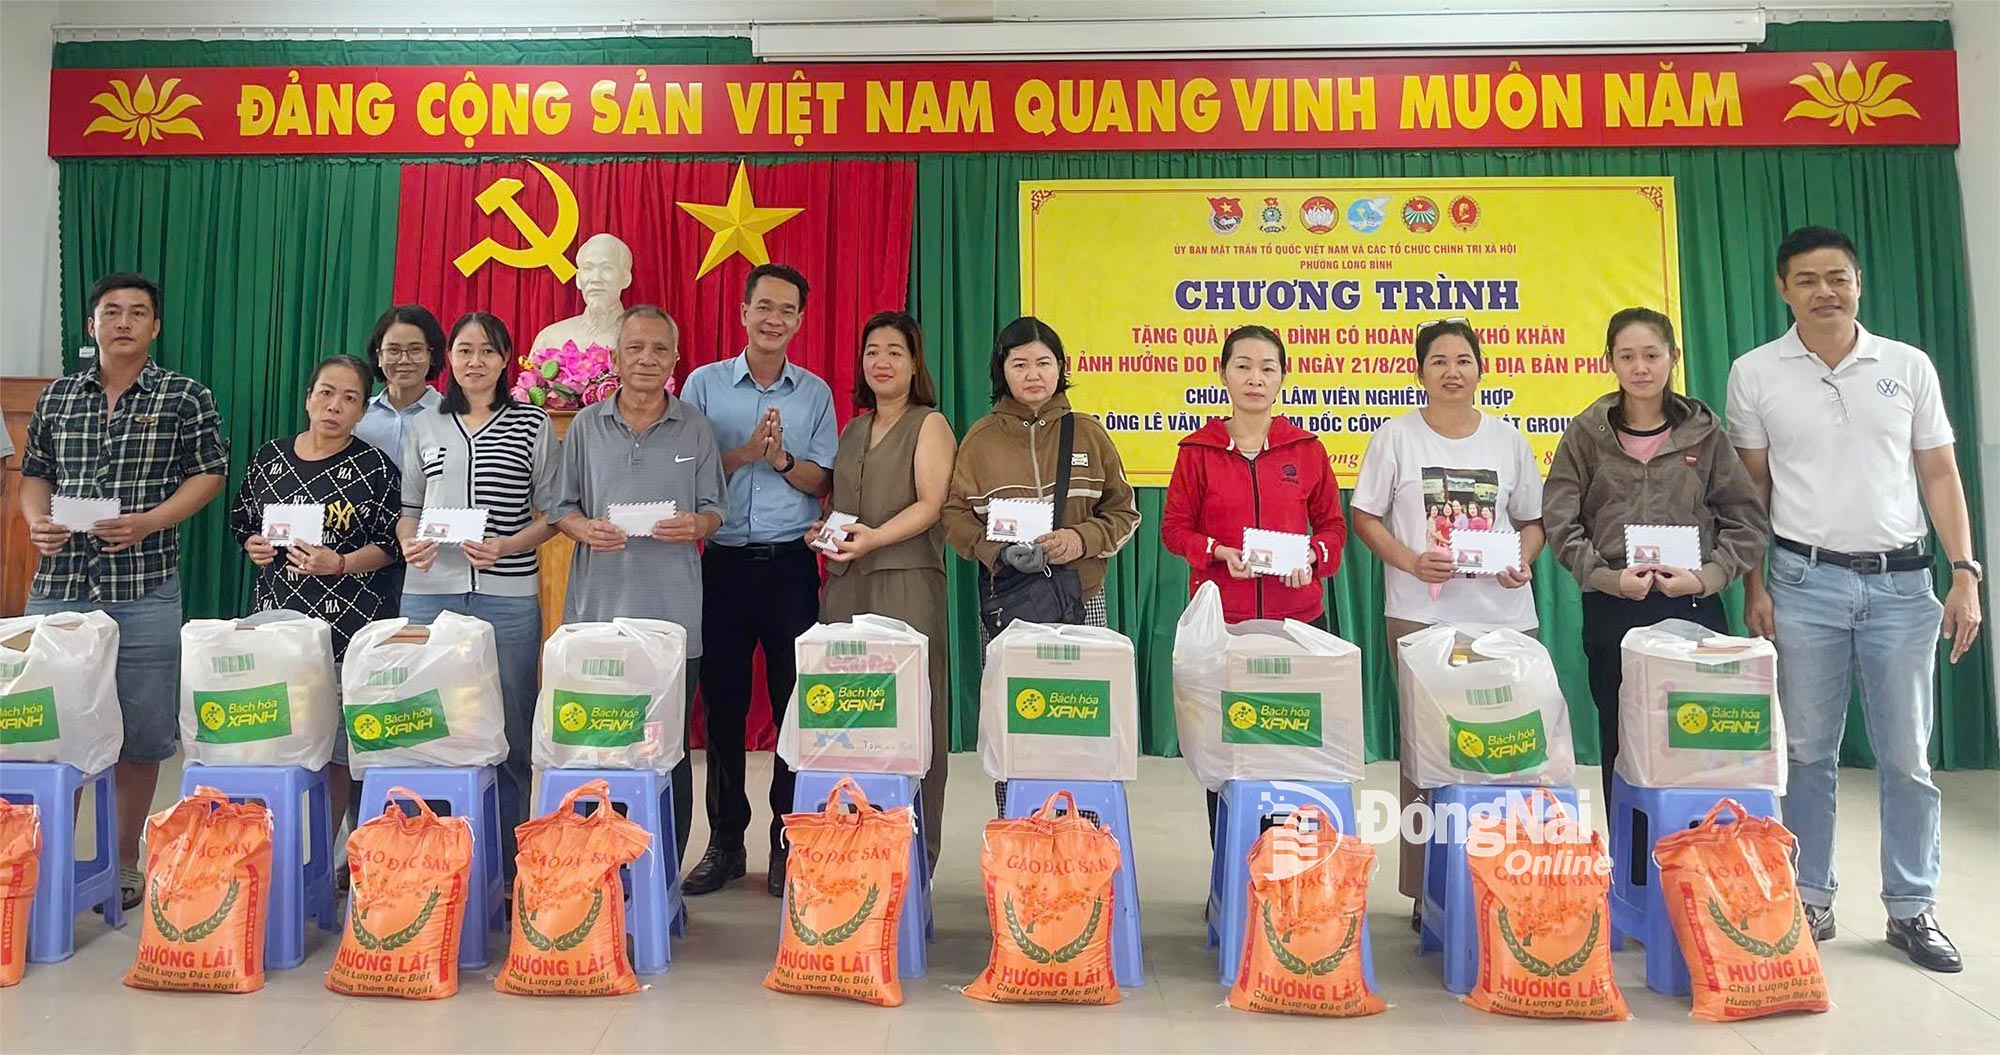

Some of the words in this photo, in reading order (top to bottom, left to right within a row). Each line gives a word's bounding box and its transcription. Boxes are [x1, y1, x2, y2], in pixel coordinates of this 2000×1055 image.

[236, 70, 394, 137] ĐẢNG
[417, 70, 572, 148] CỘNG
[591, 68, 702, 136] SẢN
[725, 69, 845, 147] VIỆT
[866, 79, 994, 134] NAM
[1015, 78, 1221, 138] QUANG
[1230, 76, 1376, 133] VINH
[1400, 60, 1583, 132] MUÔN
[1604, 61, 1744, 129] NĂM
[1174, 242, 1187, 254] ỦY
[1189, 244, 1208, 254] BAN
[1211, 242, 1230, 254] MẶT
[1233, 242, 1257, 254] TRẬN
[1260, 242, 1272, 254] TỔ
[1275, 242, 1301, 254] QUỐC
[1304, 242, 1325, 254] VIỆT
[1328, 245, 1349, 254] NAM
[1352, 242, 1365, 254] VÀ
[1367, 242, 1386, 254] CÁC
[1390, 242, 1401, 254] TỔ
[1404, 242, 1431, 254] CHỨC
[1434, 242, 1462, 254] CHÍNH
[1466, 244, 1482, 256] TRỊ
[1485, 242, 1497, 254] XÃ
[1499, 242, 1516, 256] HỘI
[1300, 259, 1339, 270] PHƯỜNG
[1342, 261, 1366, 270] LONG
[1369, 259, 1392, 270] BÌNH
[1175, 279, 1361, 311] CHƯƠNG
[1376, 273, 1520, 311] TRÌNH
[1132, 325, 1177, 347] TẶNG
[1183, 325, 1218, 345] QUÀ
[1288, 324, 1330, 345] ĐÌNH
[1337, 325, 1360, 345] CÓ
[1365, 325, 1414, 345] HOÀN
[1474, 326, 1511, 345] KHÓ
[1516, 325, 1565, 345] KHĂN
[1077, 351, 1113, 373] ẢNH
[1119, 350, 1178, 373] HƯỞNG
[1184, 356, 1207, 373] DO
[1298, 353, 1345, 373] NGÀY
[1351, 357, 1417, 374] 21/8/20
[1495, 357, 1526, 377] ĐỊA
[1532, 354, 1569, 374] BÀN
[1185, 386, 1230, 405] CHÙA
[1282, 386, 1317, 406] LÂM
[1322, 386, 1359, 406] VIÊN
[1365, 386, 1430, 406] NGHIÊM
[1481, 388, 1514, 409] HỢP
[1105, 411, 1139, 431] ÔNG
[1144, 411, 1163, 431] LÊ
[1167, 411, 1201, 431] VĂN
[1309, 410, 1341, 432] ĐỐC
[1526, 417, 1574, 433] GROU
[1329, 453, 1359, 469] ong
[836, 698, 886, 712] XANH
[1046, 704, 1099, 719] XANH
[227, 709, 278, 728] XANH
[384, 717, 433, 738] XANH
[587, 717, 634, 731] XANH
[1259, 716, 1310, 731] XANH
[1709, 720, 1760, 734] XANH
[1486, 742, 1536, 759] XANH
[140, 945, 195, 968] HƯƠNG
[202, 945, 233, 968] LÀI
[338, 946, 392, 972] HƯƠNG
[399, 951, 429, 973] LÀI
[511, 952, 569, 976] HƯƠNG
[576, 952, 605, 977] LÀI
[780, 949, 834, 972] HƯƠNG
[841, 950, 870, 973] LÀI
[1001, 966, 1067, 987] HƯƠNG
[1727, 959, 1795, 984] HƯƠNG
[1799, 953, 1820, 976] LÀI
[1257, 972, 1325, 1000] HƯƠNG
[1500, 973, 1571, 998] HƯƠNG
